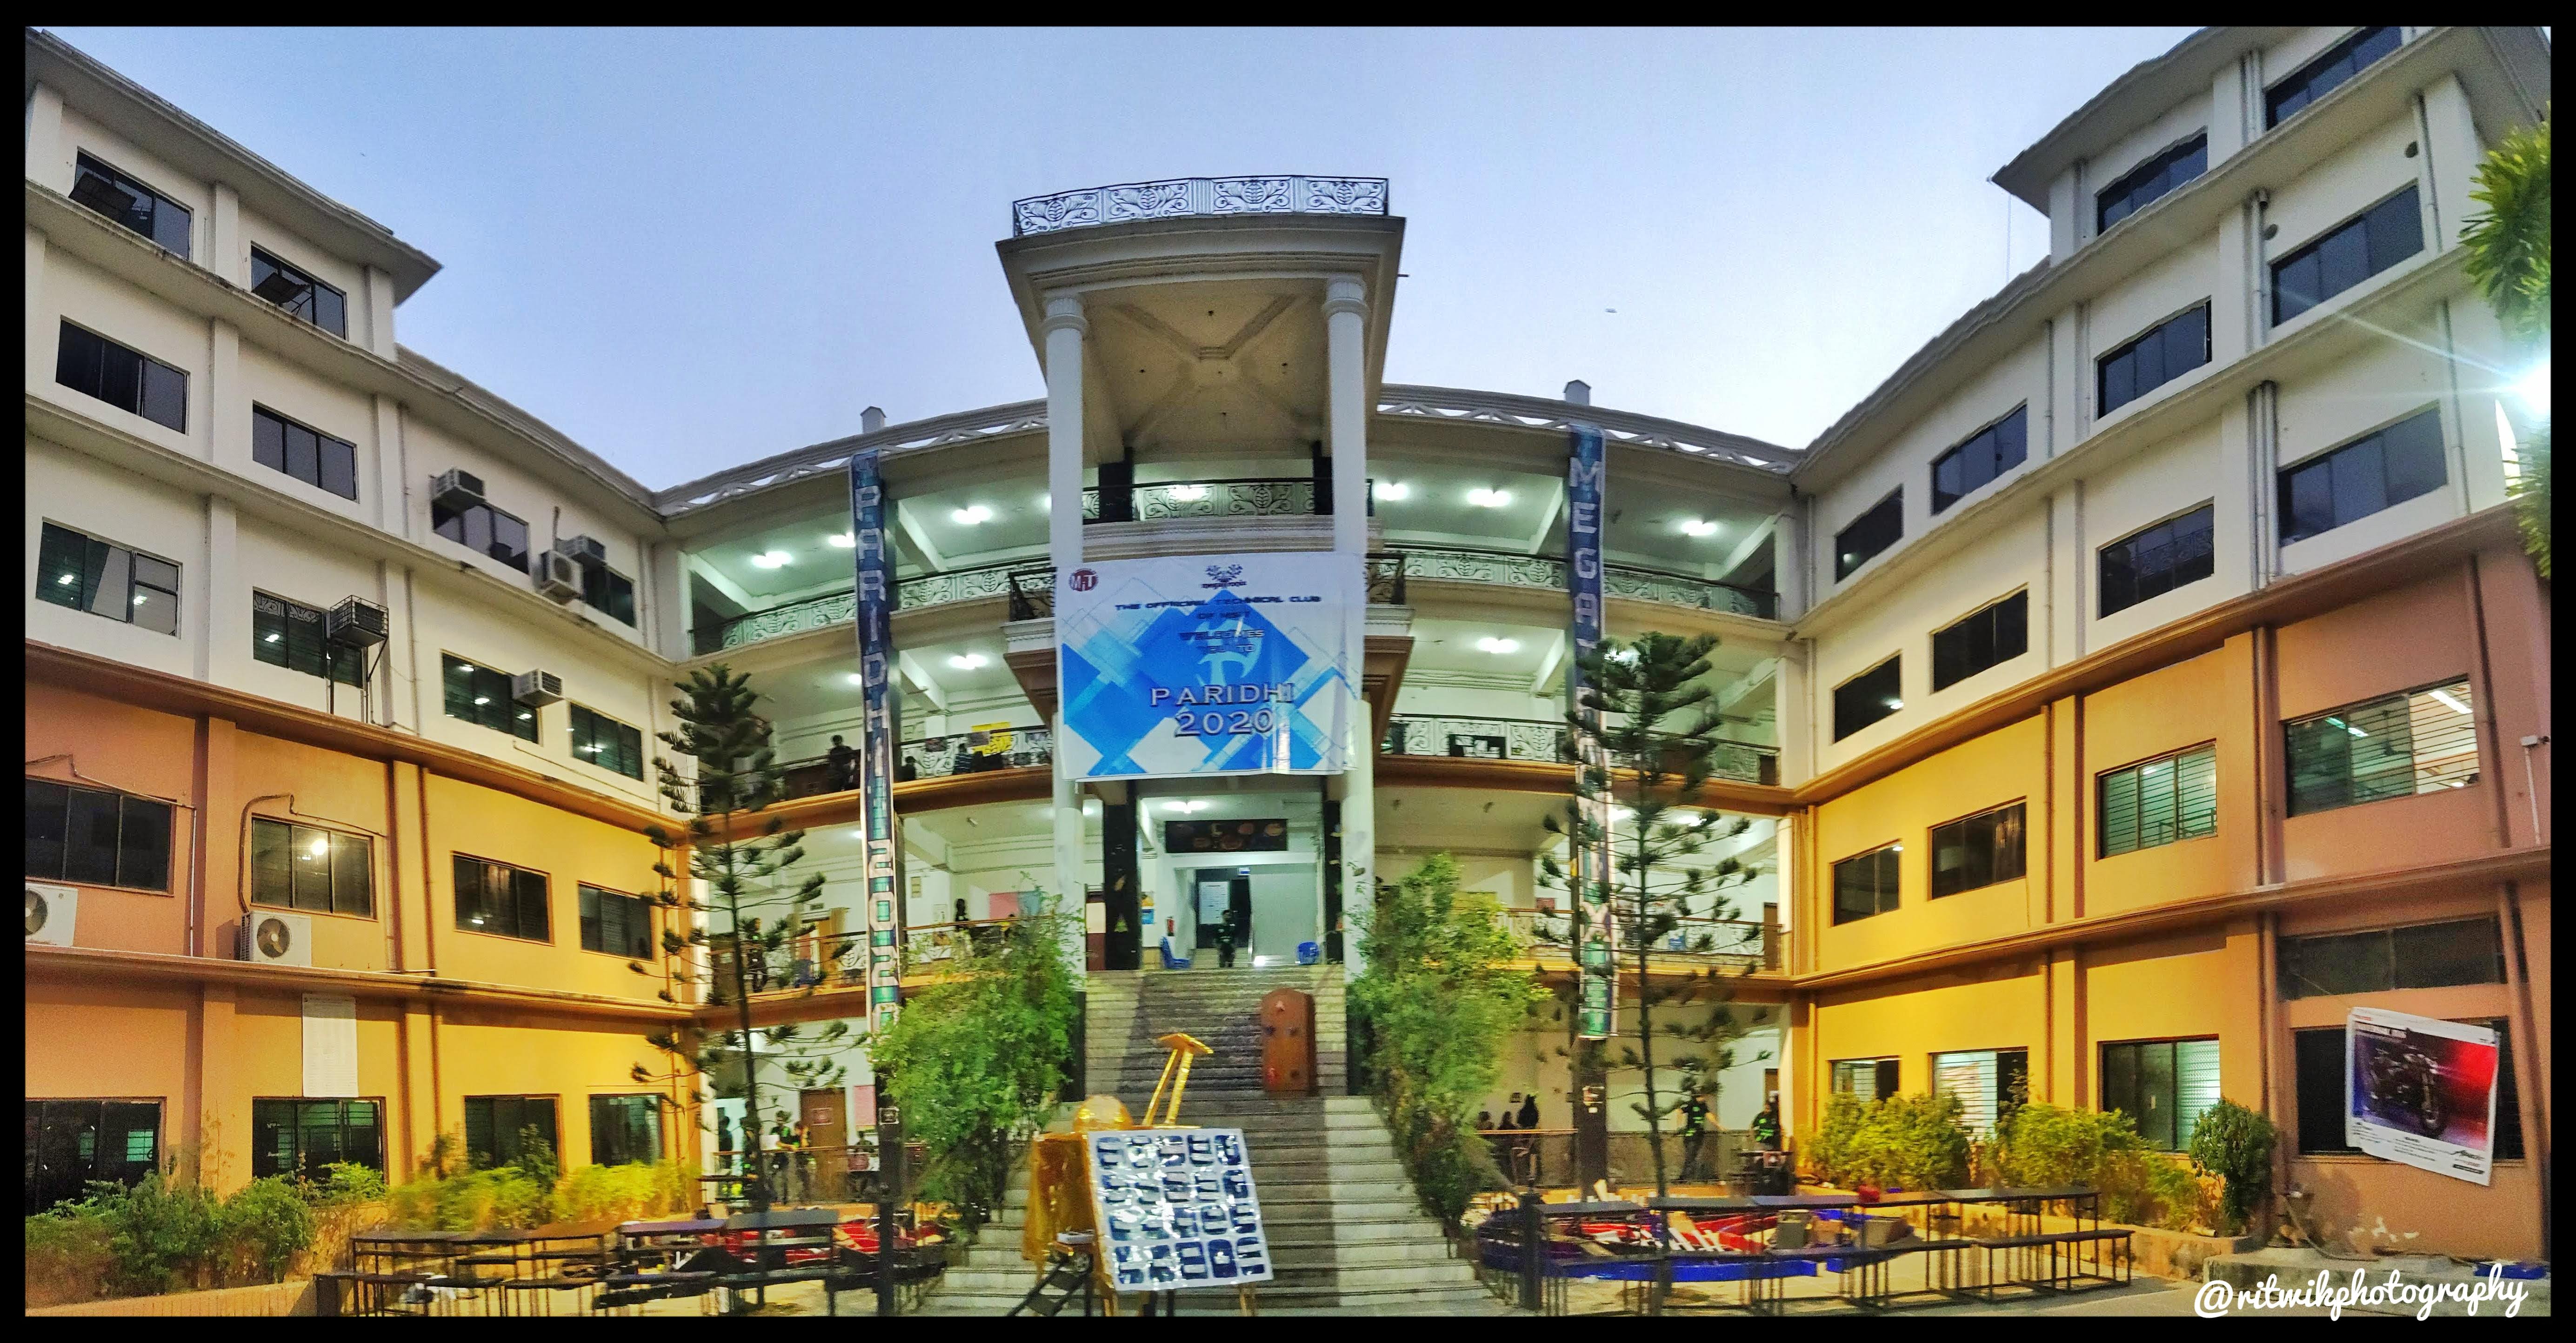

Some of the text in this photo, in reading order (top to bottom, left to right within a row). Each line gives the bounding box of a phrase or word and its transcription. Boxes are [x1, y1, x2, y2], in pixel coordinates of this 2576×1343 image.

[1215, 596, 1284, 605] TECHNICAL
[854, 485, 888, 777] PARIDHI
[1150, 682, 1295, 707] PARIDHI
[1174, 708, 1275, 738] 2020
